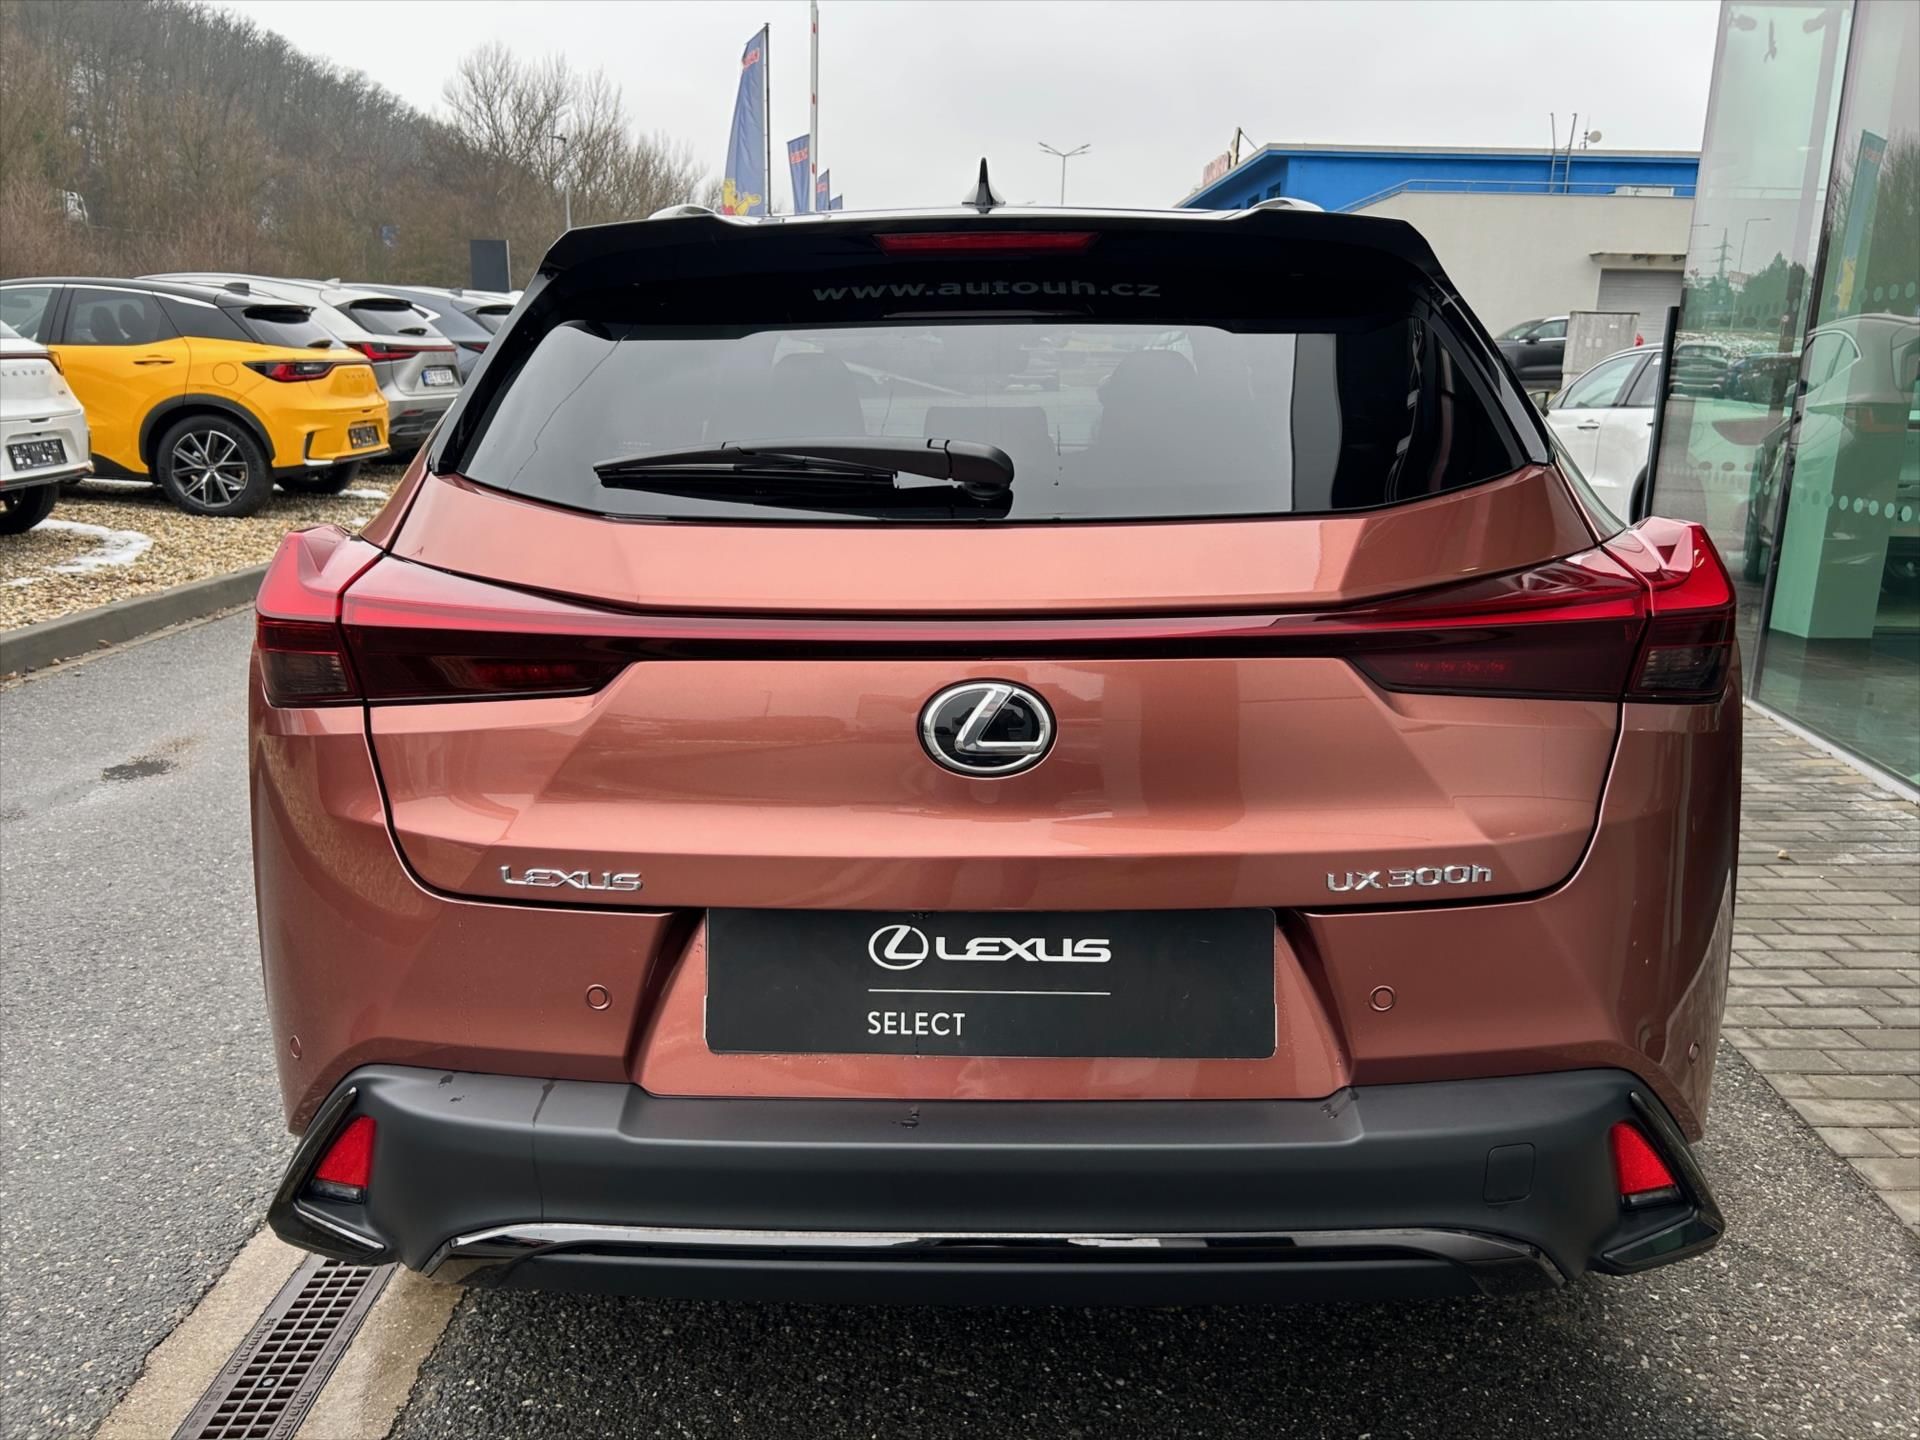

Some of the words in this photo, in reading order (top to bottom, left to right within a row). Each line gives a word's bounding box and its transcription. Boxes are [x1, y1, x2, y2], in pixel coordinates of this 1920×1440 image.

[812, 279, 1161, 301] www.autouh.cz
[500, 865, 643, 891] LEXUS
[1326, 871, 1384, 892] UX
[1387, 864, 1492, 888] 300h
[936, 936, 1112, 963] LEXUS
[867, 1011, 966, 1036] SELECT
